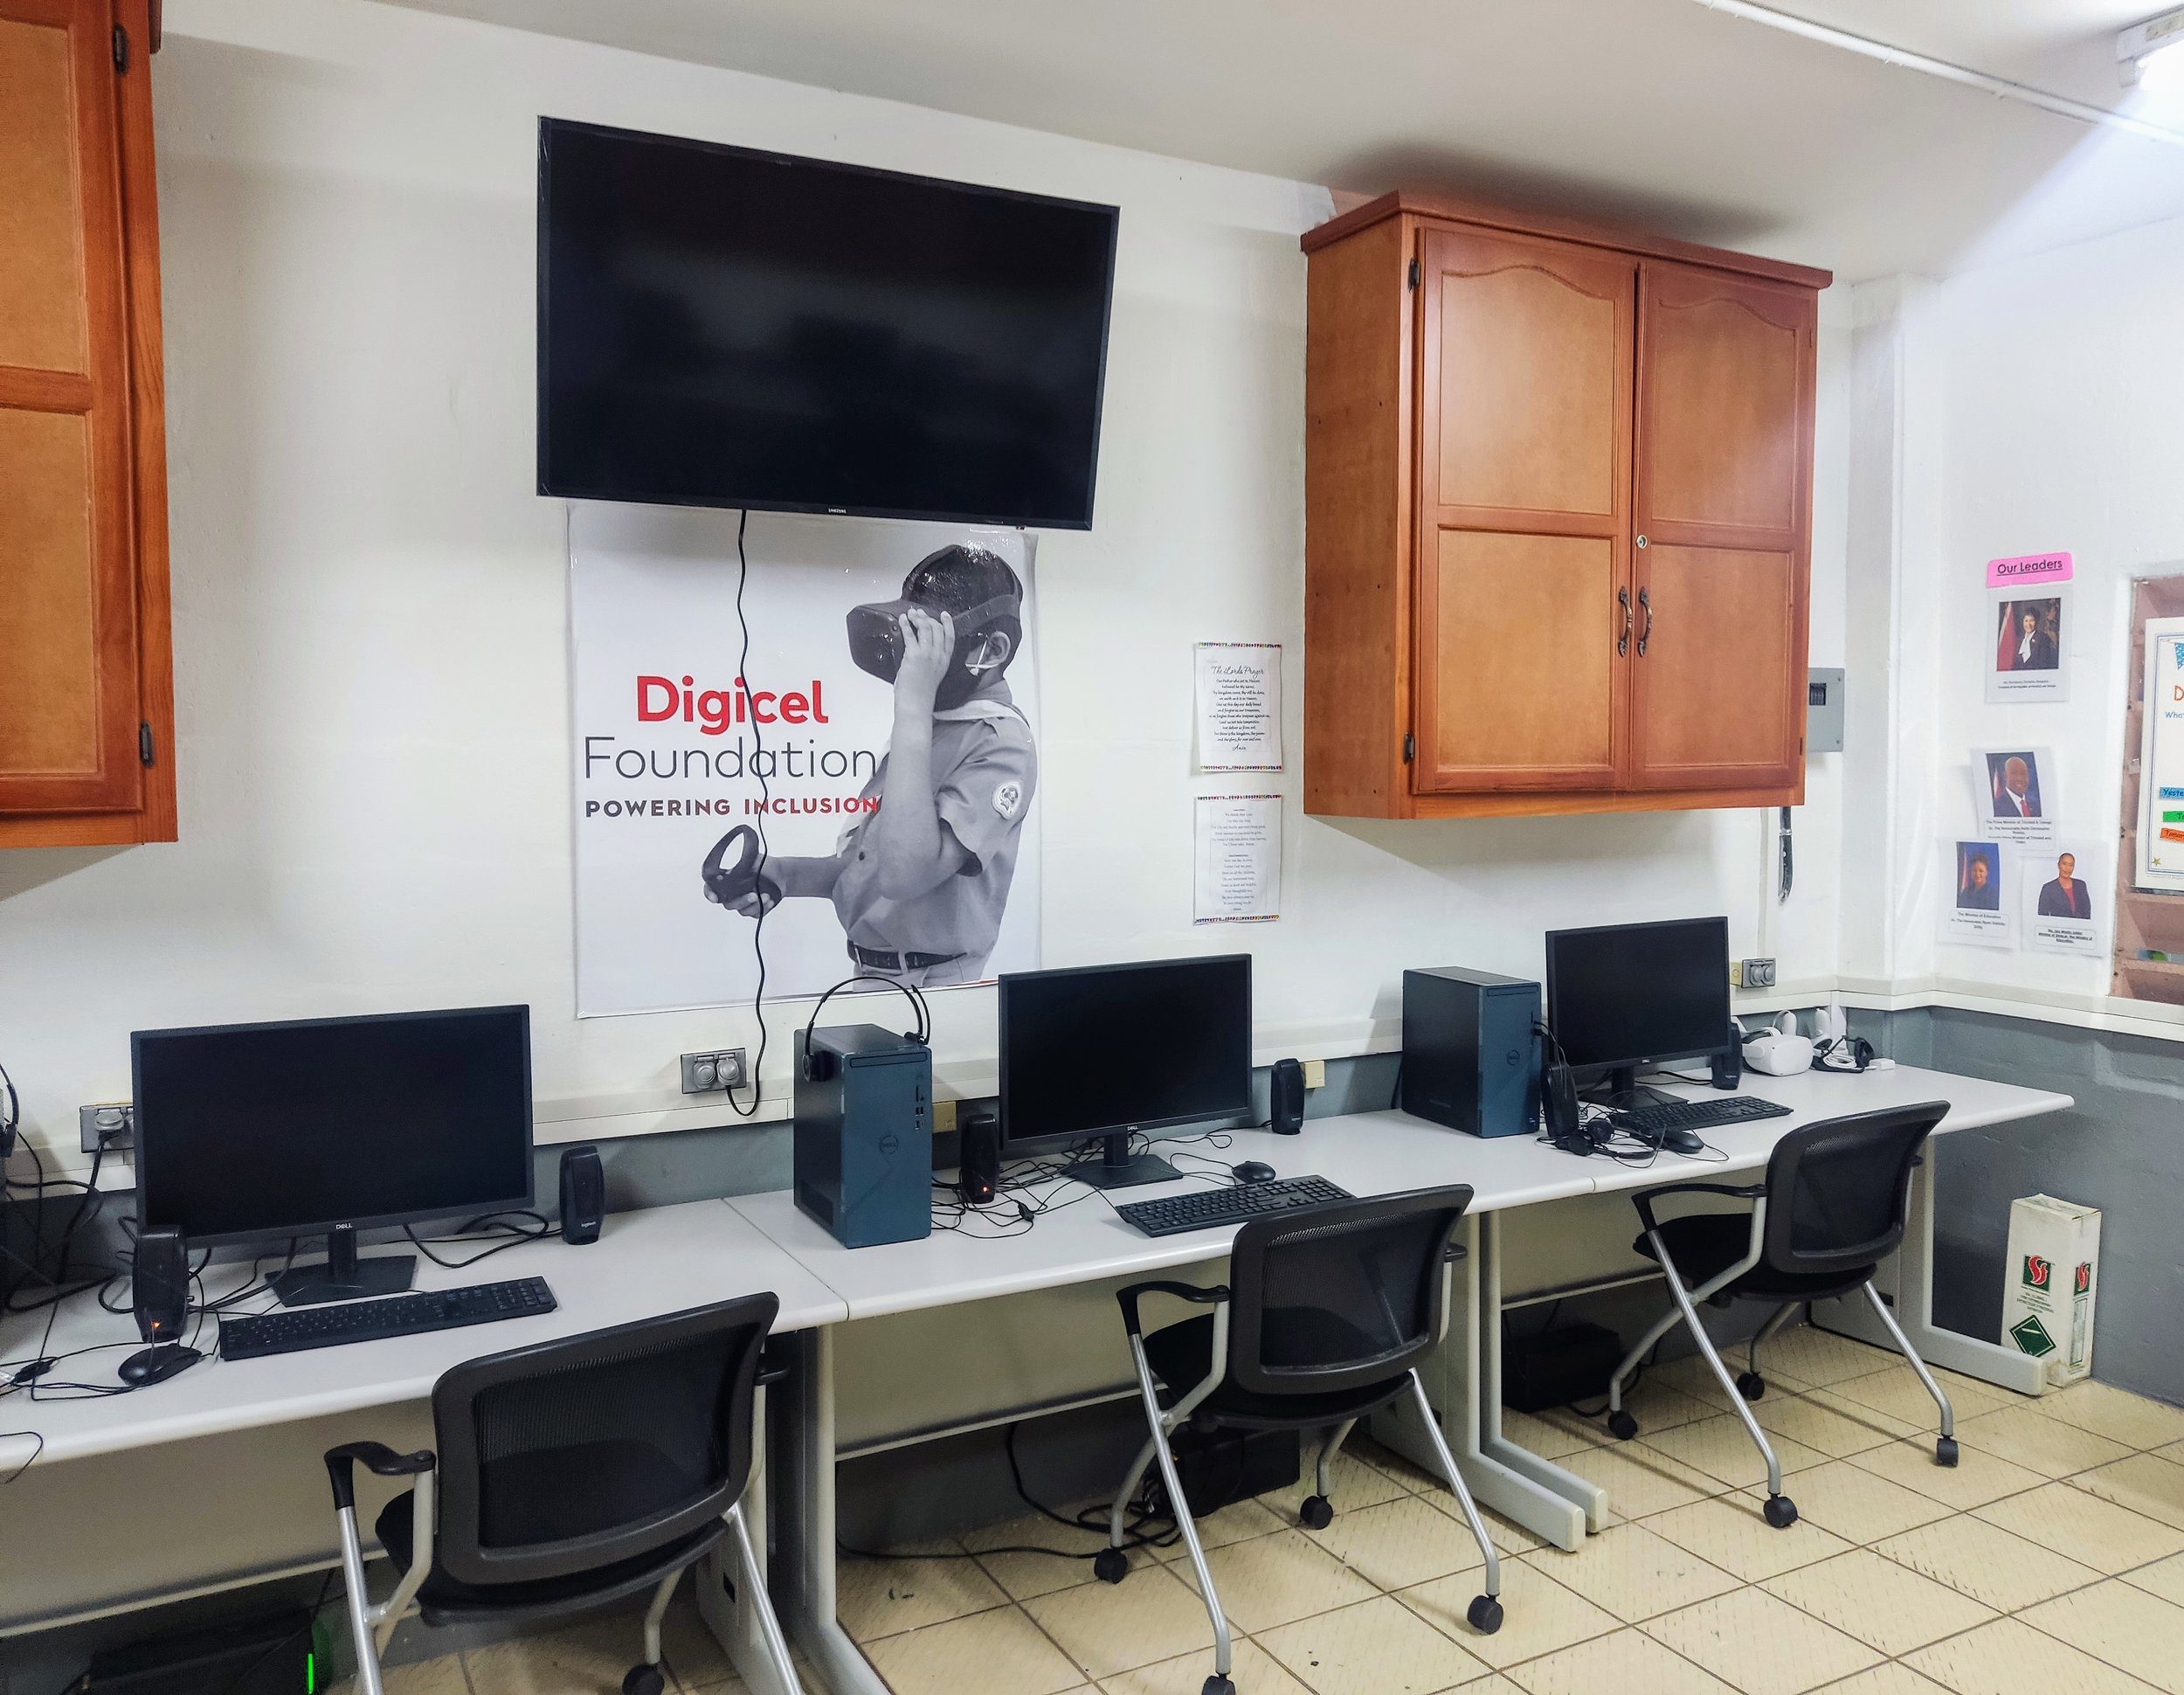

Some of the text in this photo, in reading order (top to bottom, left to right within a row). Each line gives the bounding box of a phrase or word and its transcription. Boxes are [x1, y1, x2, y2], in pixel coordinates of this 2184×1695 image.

[1997, 559, 2063, 574] Our Leaders
[637, 675, 829, 736] Digicel
[584, 736, 876, 779] Foundation
[585, 796, 882, 818] POWERING INCLUSION
